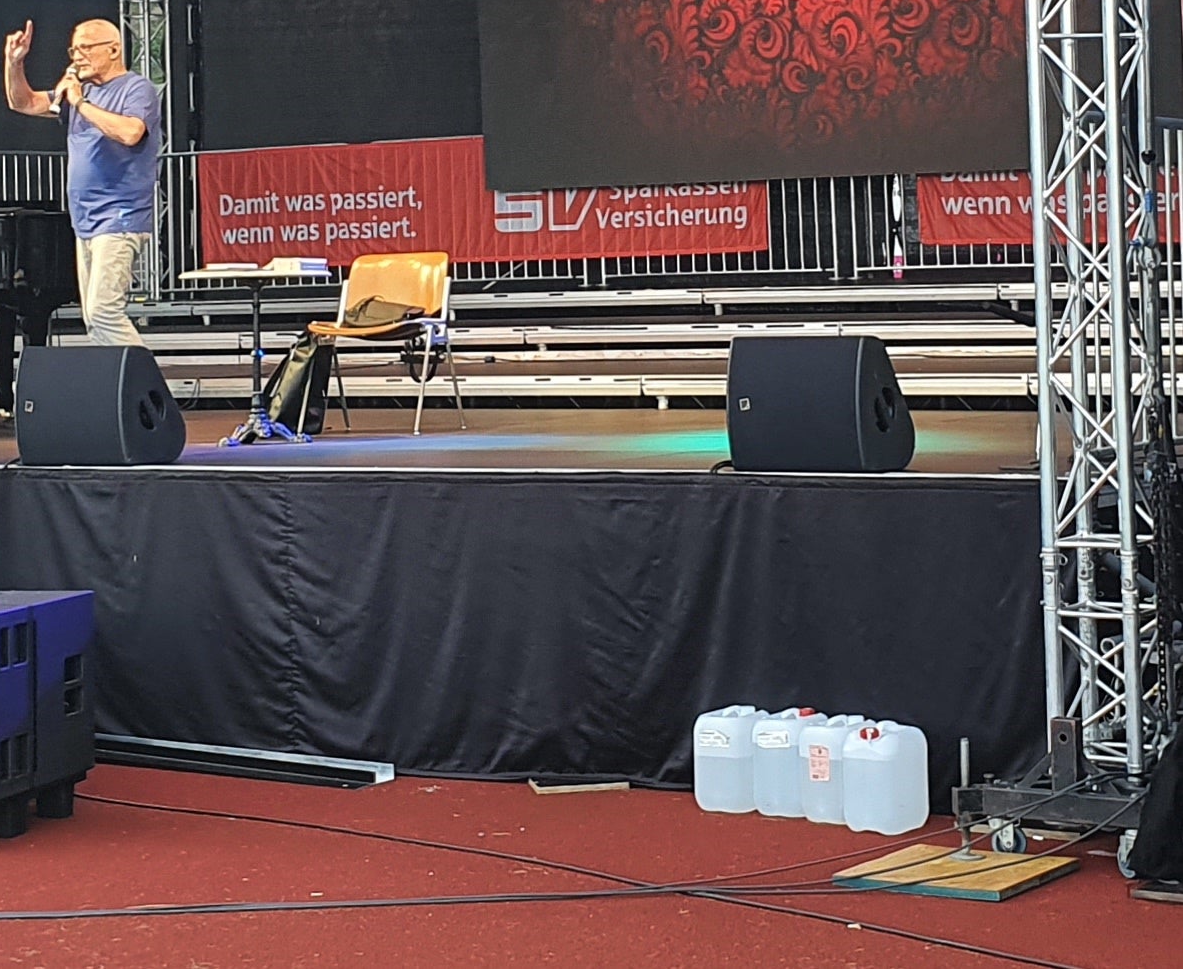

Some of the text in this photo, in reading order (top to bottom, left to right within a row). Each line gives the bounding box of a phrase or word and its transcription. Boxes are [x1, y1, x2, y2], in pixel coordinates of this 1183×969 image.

[219, 185, 423, 216] Damit was passiert,
[940, 194, 1011, 215] wenn
[220, 215, 417, 246] wenn was passiert.
[595, 202, 748, 230] Versicherung
